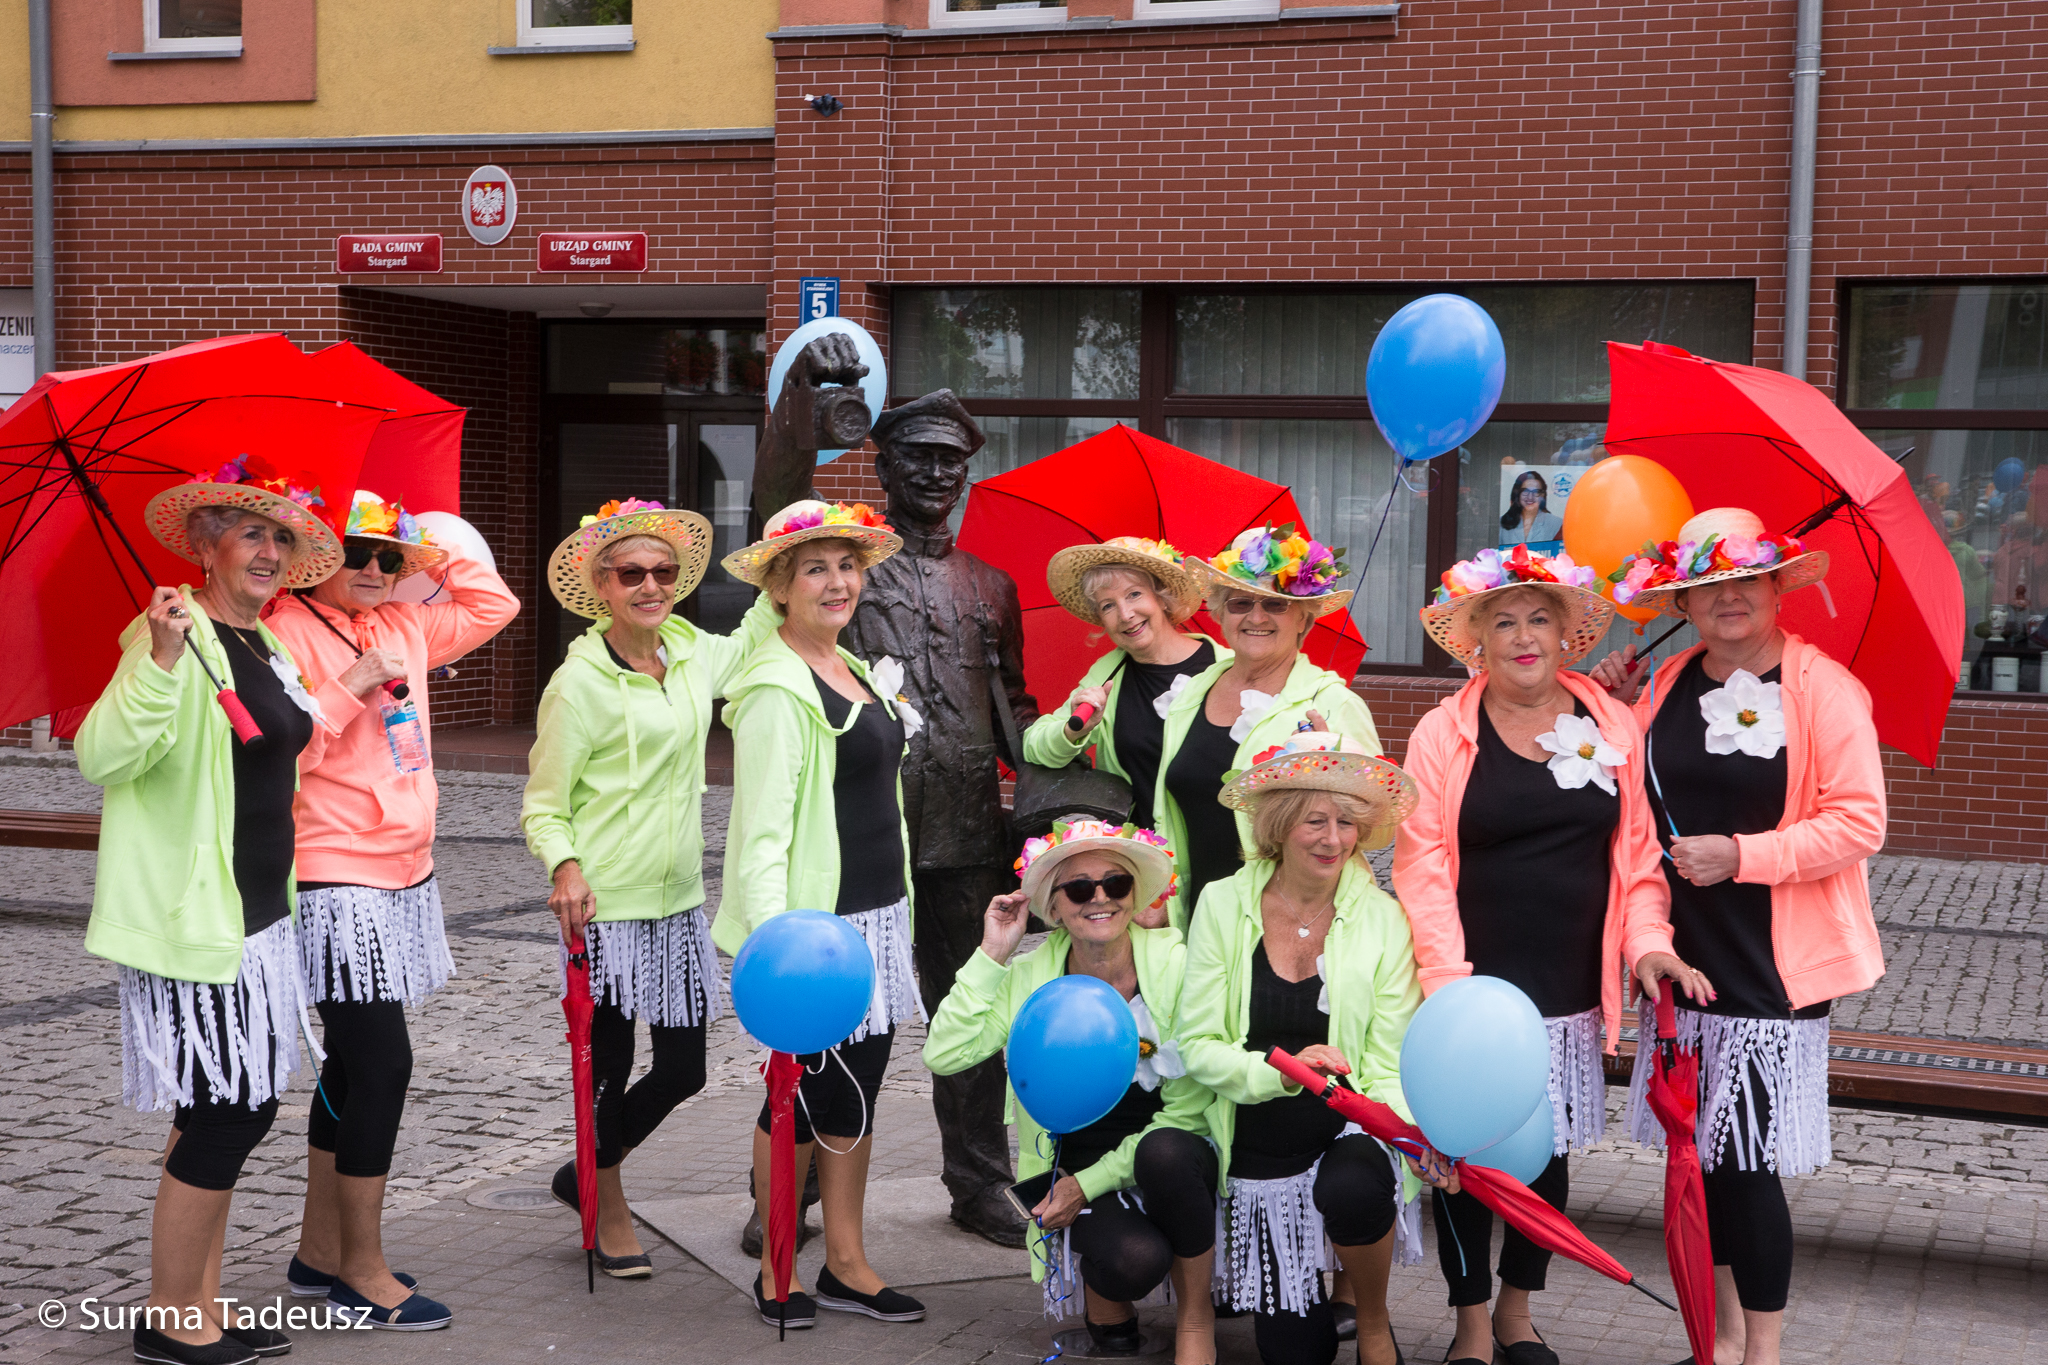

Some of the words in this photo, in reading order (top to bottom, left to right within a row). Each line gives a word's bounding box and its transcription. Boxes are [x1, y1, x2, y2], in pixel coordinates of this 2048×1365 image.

[352, 242, 382, 253] RADA
[385, 242, 424, 253] GMINY
[550, 240, 589, 254] URZĄD
[592, 240, 633, 251] GMINY
[367, 255, 407, 268] Stargard
[569, 254, 611, 267] Stargard
[811, 292, 827, 319] 5
